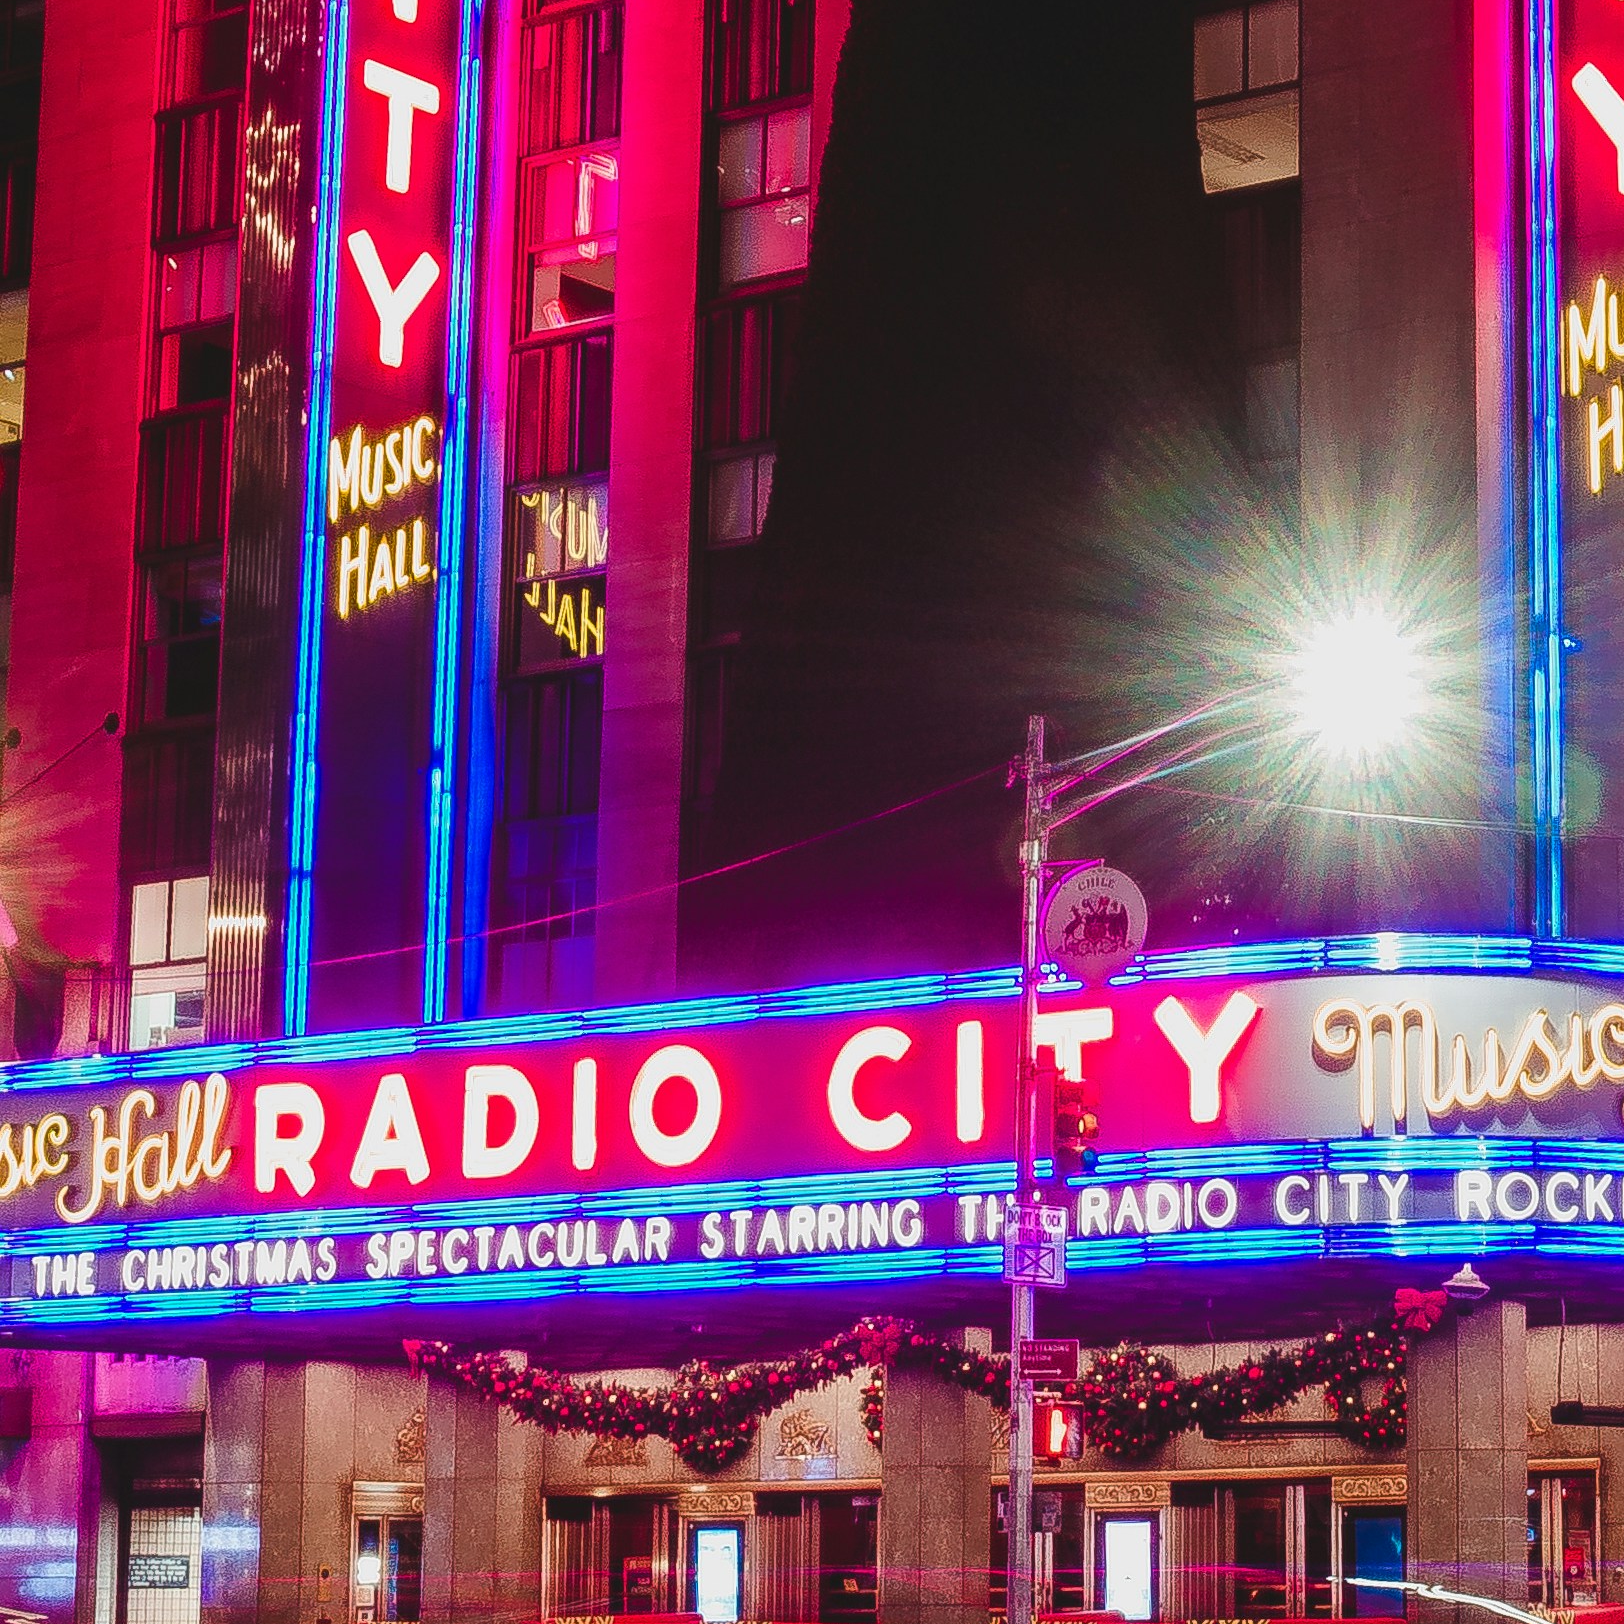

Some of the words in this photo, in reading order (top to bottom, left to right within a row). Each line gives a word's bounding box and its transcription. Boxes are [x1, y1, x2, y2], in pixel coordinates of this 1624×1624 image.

[1078, 876, 1116, 892] CHILE
[54, 1071, 233, 1225] Hall
[252, 1043, 724, 1197] RADIO
[827, 991, 1264, 1153] CITY
[31, 1251, 97, 1299] THE
[121, 1236, 338, 1292] CHRISTMAS
[365, 1215, 671, 1280] SPECTACULAR
[700, 1190, 924, 1256] STARRING
[1080, 1178, 1238, 1237] RADIO
[1275, 1173, 1408, 1227] CITY
